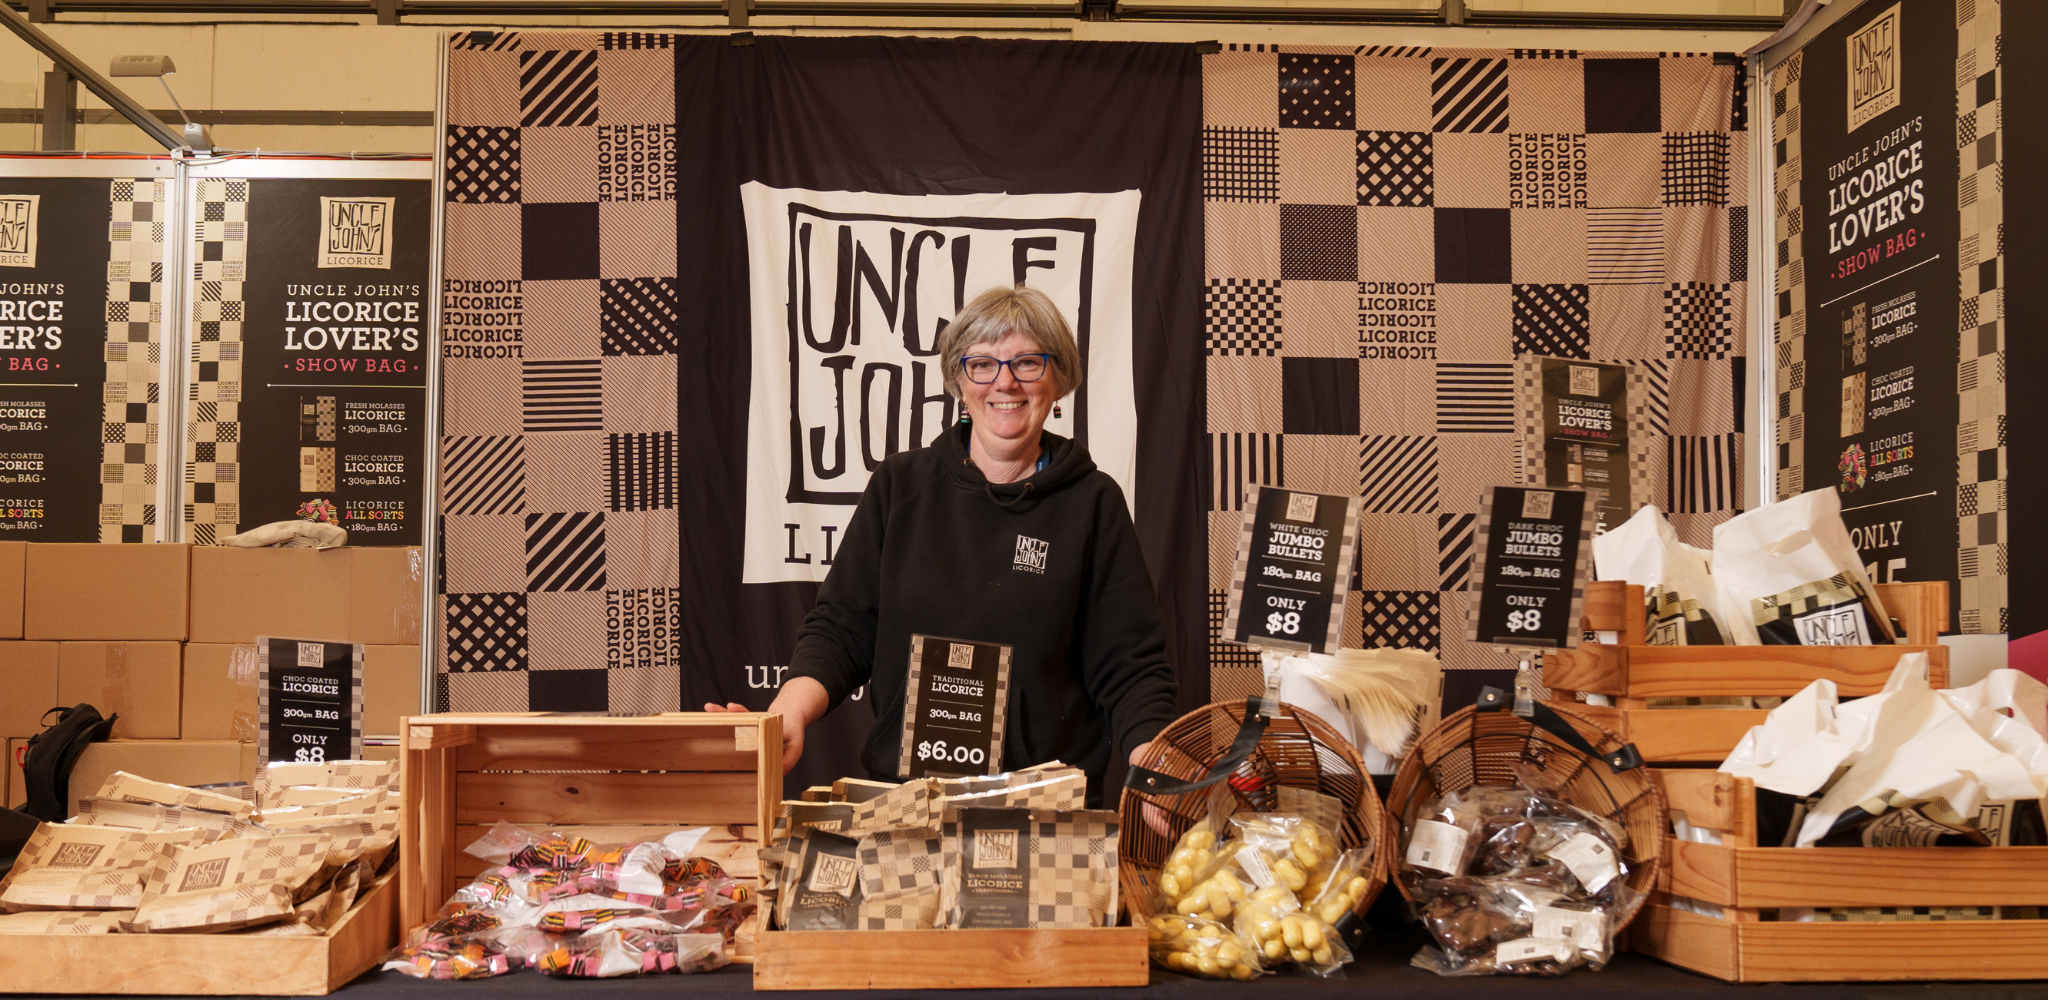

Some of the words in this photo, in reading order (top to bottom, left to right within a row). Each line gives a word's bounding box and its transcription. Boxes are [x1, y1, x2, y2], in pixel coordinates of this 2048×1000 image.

[1853, 20, 1891, 72] UNCLE
[1853, 92, 1895, 126] LICORICE
[1828, 146, 1869, 181] UNCLE
[1872, 115, 1923, 157] JOHN'S
[598, 124, 611, 202] LICORICE
[615, 124, 628, 202] LICORICE
[631, 124, 644, 202] LICORICE
[647, 123, 661, 201] LICORICE
[664, 123, 677, 201] LICORICE
[1509, 132, 1523, 208] LICORICE
[1525, 132, 1539, 209] LICORICE
[1541, 132, 1555, 208] LICORICE
[1557, 132, 1571, 209] LICORICE
[1573, 132, 1587, 208] LICORICE
[1828, 139, 1923, 217] LICORICE
[331, 203, 381, 229] UNCLE
[1828, 178, 1925, 255] LOVER'S
[327, 256, 384, 266] LICORICE
[1838, 243, 1881, 279] SHOW
[1885, 228, 1917, 258] BAG
[287, 284, 347, 296] UNCLE
[353, 284, 420, 297] JOHN'S
[445, 279, 522, 294] LICORICE
[1358, 281, 1435, 295] LICORICE
[444, 296, 523, 310] LICORICE
[1358, 298, 1436, 311] LICORICE
[1871, 304, 1888, 315] FRESH
[285, 301, 420, 322] LICORICE
[444, 312, 522, 326] LICORICE
[1871, 301, 1917, 330] LICORICE
[1358, 313, 1436, 327] LICORICE
[444, 328, 523, 342] LICORICE
[1358, 330, 1436, 343] LICORICE
[1895, 321, 1914, 339] BAG
[284, 326, 420, 352] LOVER'S
[443, 344, 523, 359] LICORICE
[1358, 345, 1437, 359] LICORICE
[9, 358, 49, 371] BAG
[295, 357, 358, 372] SHOW
[365, 358, 407, 373] BAG
[1871, 377, 1889, 387] CHOC
[1889, 366, 1914, 381] COATED
[1870, 376, 1915, 402] LICORICE
[1893, 396, 1911, 412] BAG
[344, 410, 406, 421] LICORICE
[1557, 405, 1612, 420] LICORICE
[19, 422, 42, 431] BAG
[347, 425, 378, 434] 300gm
[378, 423, 402, 433] BAG
[1558, 415, 1613, 431] LOVER'S
[1563, 428, 1590, 437] SHOW
[1590, 431, 1608, 439] BAG
[1869, 431, 1914, 453] LICORICE
[1870, 452, 1886, 467] ALL
[1886, 445, 1914, 464] SORTS
[344, 462, 404, 473] LICORICE
[1892, 464, 1909, 477] BAG
[18, 474, 40, 483] BAG
[347, 477, 377, 486] 300gm
[377, 476, 401, 485] BAG
[8, 508, 44, 518] SORTS
[345, 501, 405, 510] LICORICE
[345, 510, 367, 520] ALL
[368, 510, 405, 520] SORTS
[17, 521, 37, 530] BAG
[351, 523, 376, 532] 180gm
[376, 522, 398, 531] BAG
[1269, 522, 1300, 534] WHITE
[1301, 526, 1329, 537] CHOC
[1508, 522, 1535, 532] DARK
[1535, 523, 1564, 533] CHOC
[1269, 531, 1325, 549] JUMBO
[1505, 531, 1563, 546] JUMBO
[1850, 520, 1903, 552] ONLY
[1267, 544, 1323, 561] BULLETS
[1504, 544, 1562, 557] BULLETS
[1294, 570, 1322, 583] BAG
[1533, 567, 1562, 579] BAG
[1266, 596, 1307, 611] ONLY
[1506, 595, 1547, 608] ONLY
[623, 588, 635, 669] LICORICE
[637, 587, 651, 668] LICORICE
[652, 587, 667, 667] LICORICE
[1265, 611, 1301, 635] $8
[1506, 609, 1542, 633] $8
[606, 589, 620, 669] LICORICE
[282, 675, 306, 683] CHOC
[306, 677, 339, 685] COATED
[932, 674, 985, 687] TRADITIONAL
[282, 682, 339, 695] LICORICE
[931, 682, 984, 697] LICORICE
[314, 709, 339, 720] BAG
[958, 711, 982, 722] BAG
[292, 734, 328, 745] ONLY
[294, 747, 325, 762] $8
[917, 740, 985, 765] $6.00
[967, 879, 1023, 889] LICORICE
